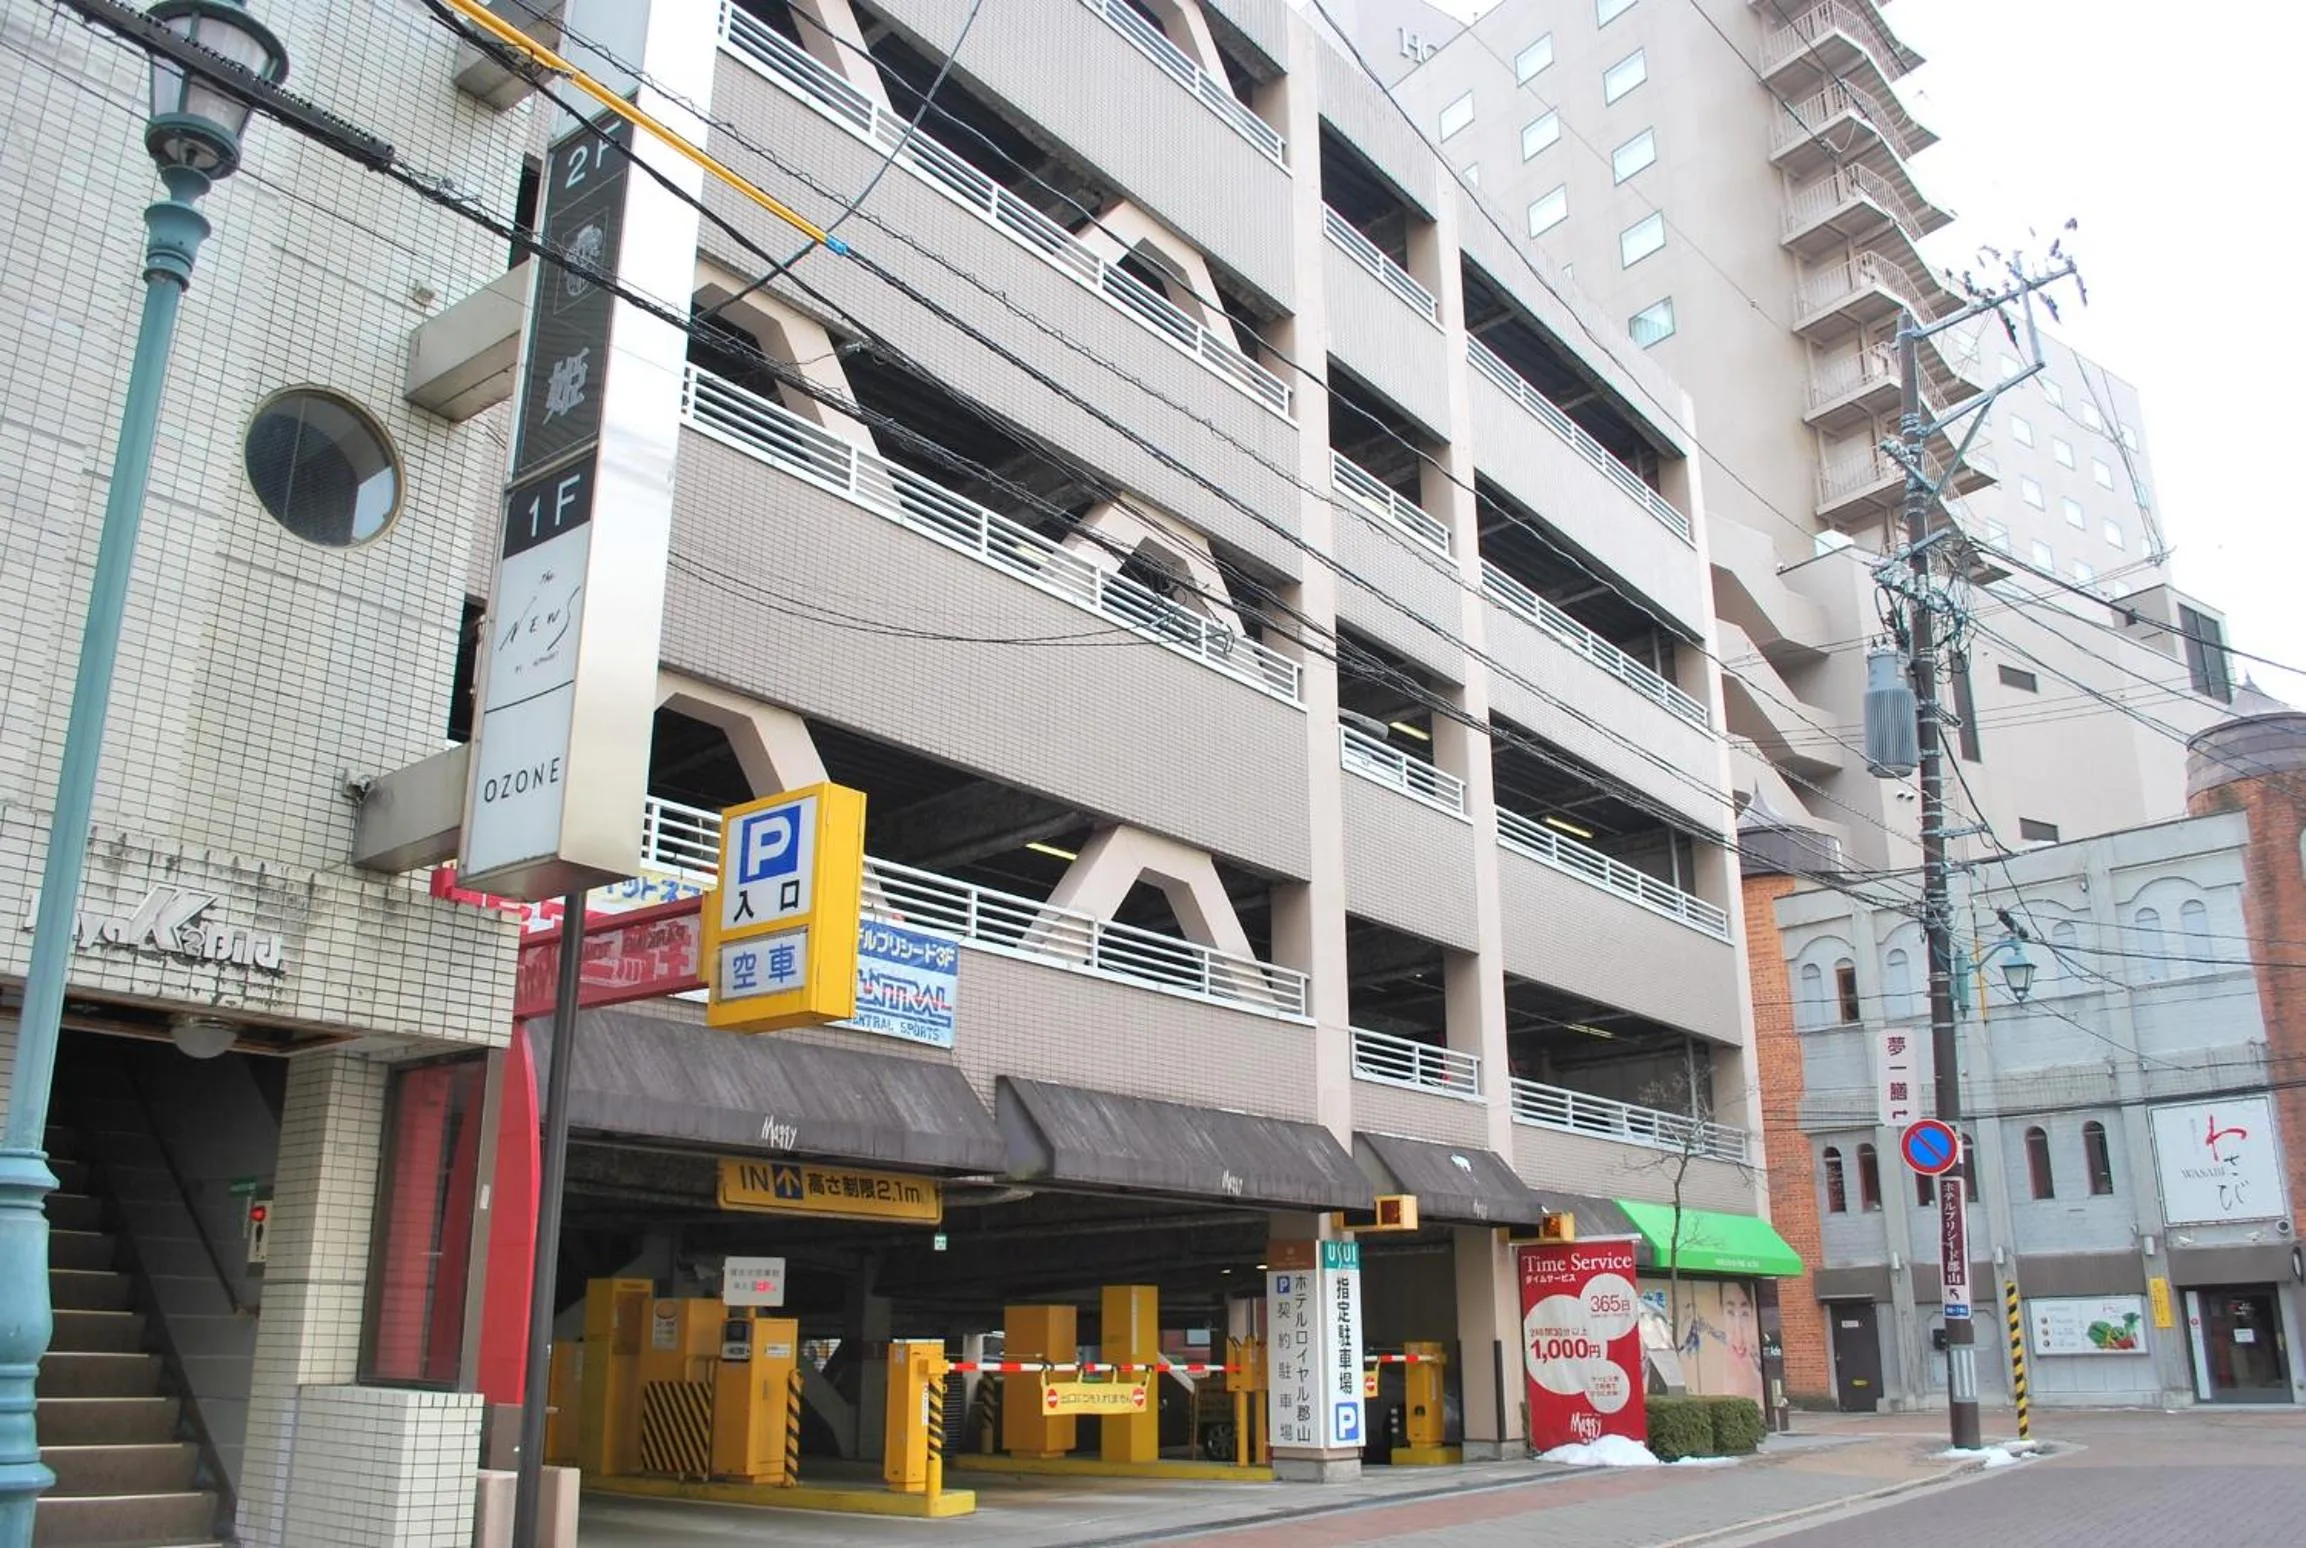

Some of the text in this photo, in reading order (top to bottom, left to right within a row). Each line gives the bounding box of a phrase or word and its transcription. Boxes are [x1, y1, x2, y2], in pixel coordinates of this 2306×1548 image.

[565, 119, 622, 190] 2F
[528, 473, 581, 538] 1F
[484, 757, 561, 804] OZONE
[747, 815, 792, 877] P
[733, 879, 800, 923] 入口
[732, 943, 797, 990] 空車
[900, 1021, 940, 1041] SPORTS
[739, 1164, 770, 1192] IN
[2181, 1166, 2226, 1179] WASABI
[2205, 1113, 2249, 1212] わさび
[807, 1172, 921, 1204] 高さ制限2.1m
[1522, 1252, 1633, 1273] Time Service
[1525, 1273, 1576, 1285] タイムサービス
[1590, 1294, 1631, 1313] 365日
[1336, 1275, 1353, 1395] 指定駐車場
[1531, 1338, 1601, 1364] 1,000円
[1277, 1301, 1294, 1441] 契約駐車場
[1295, 1275, 1311, 1442] ホテルロイヤル郡山
